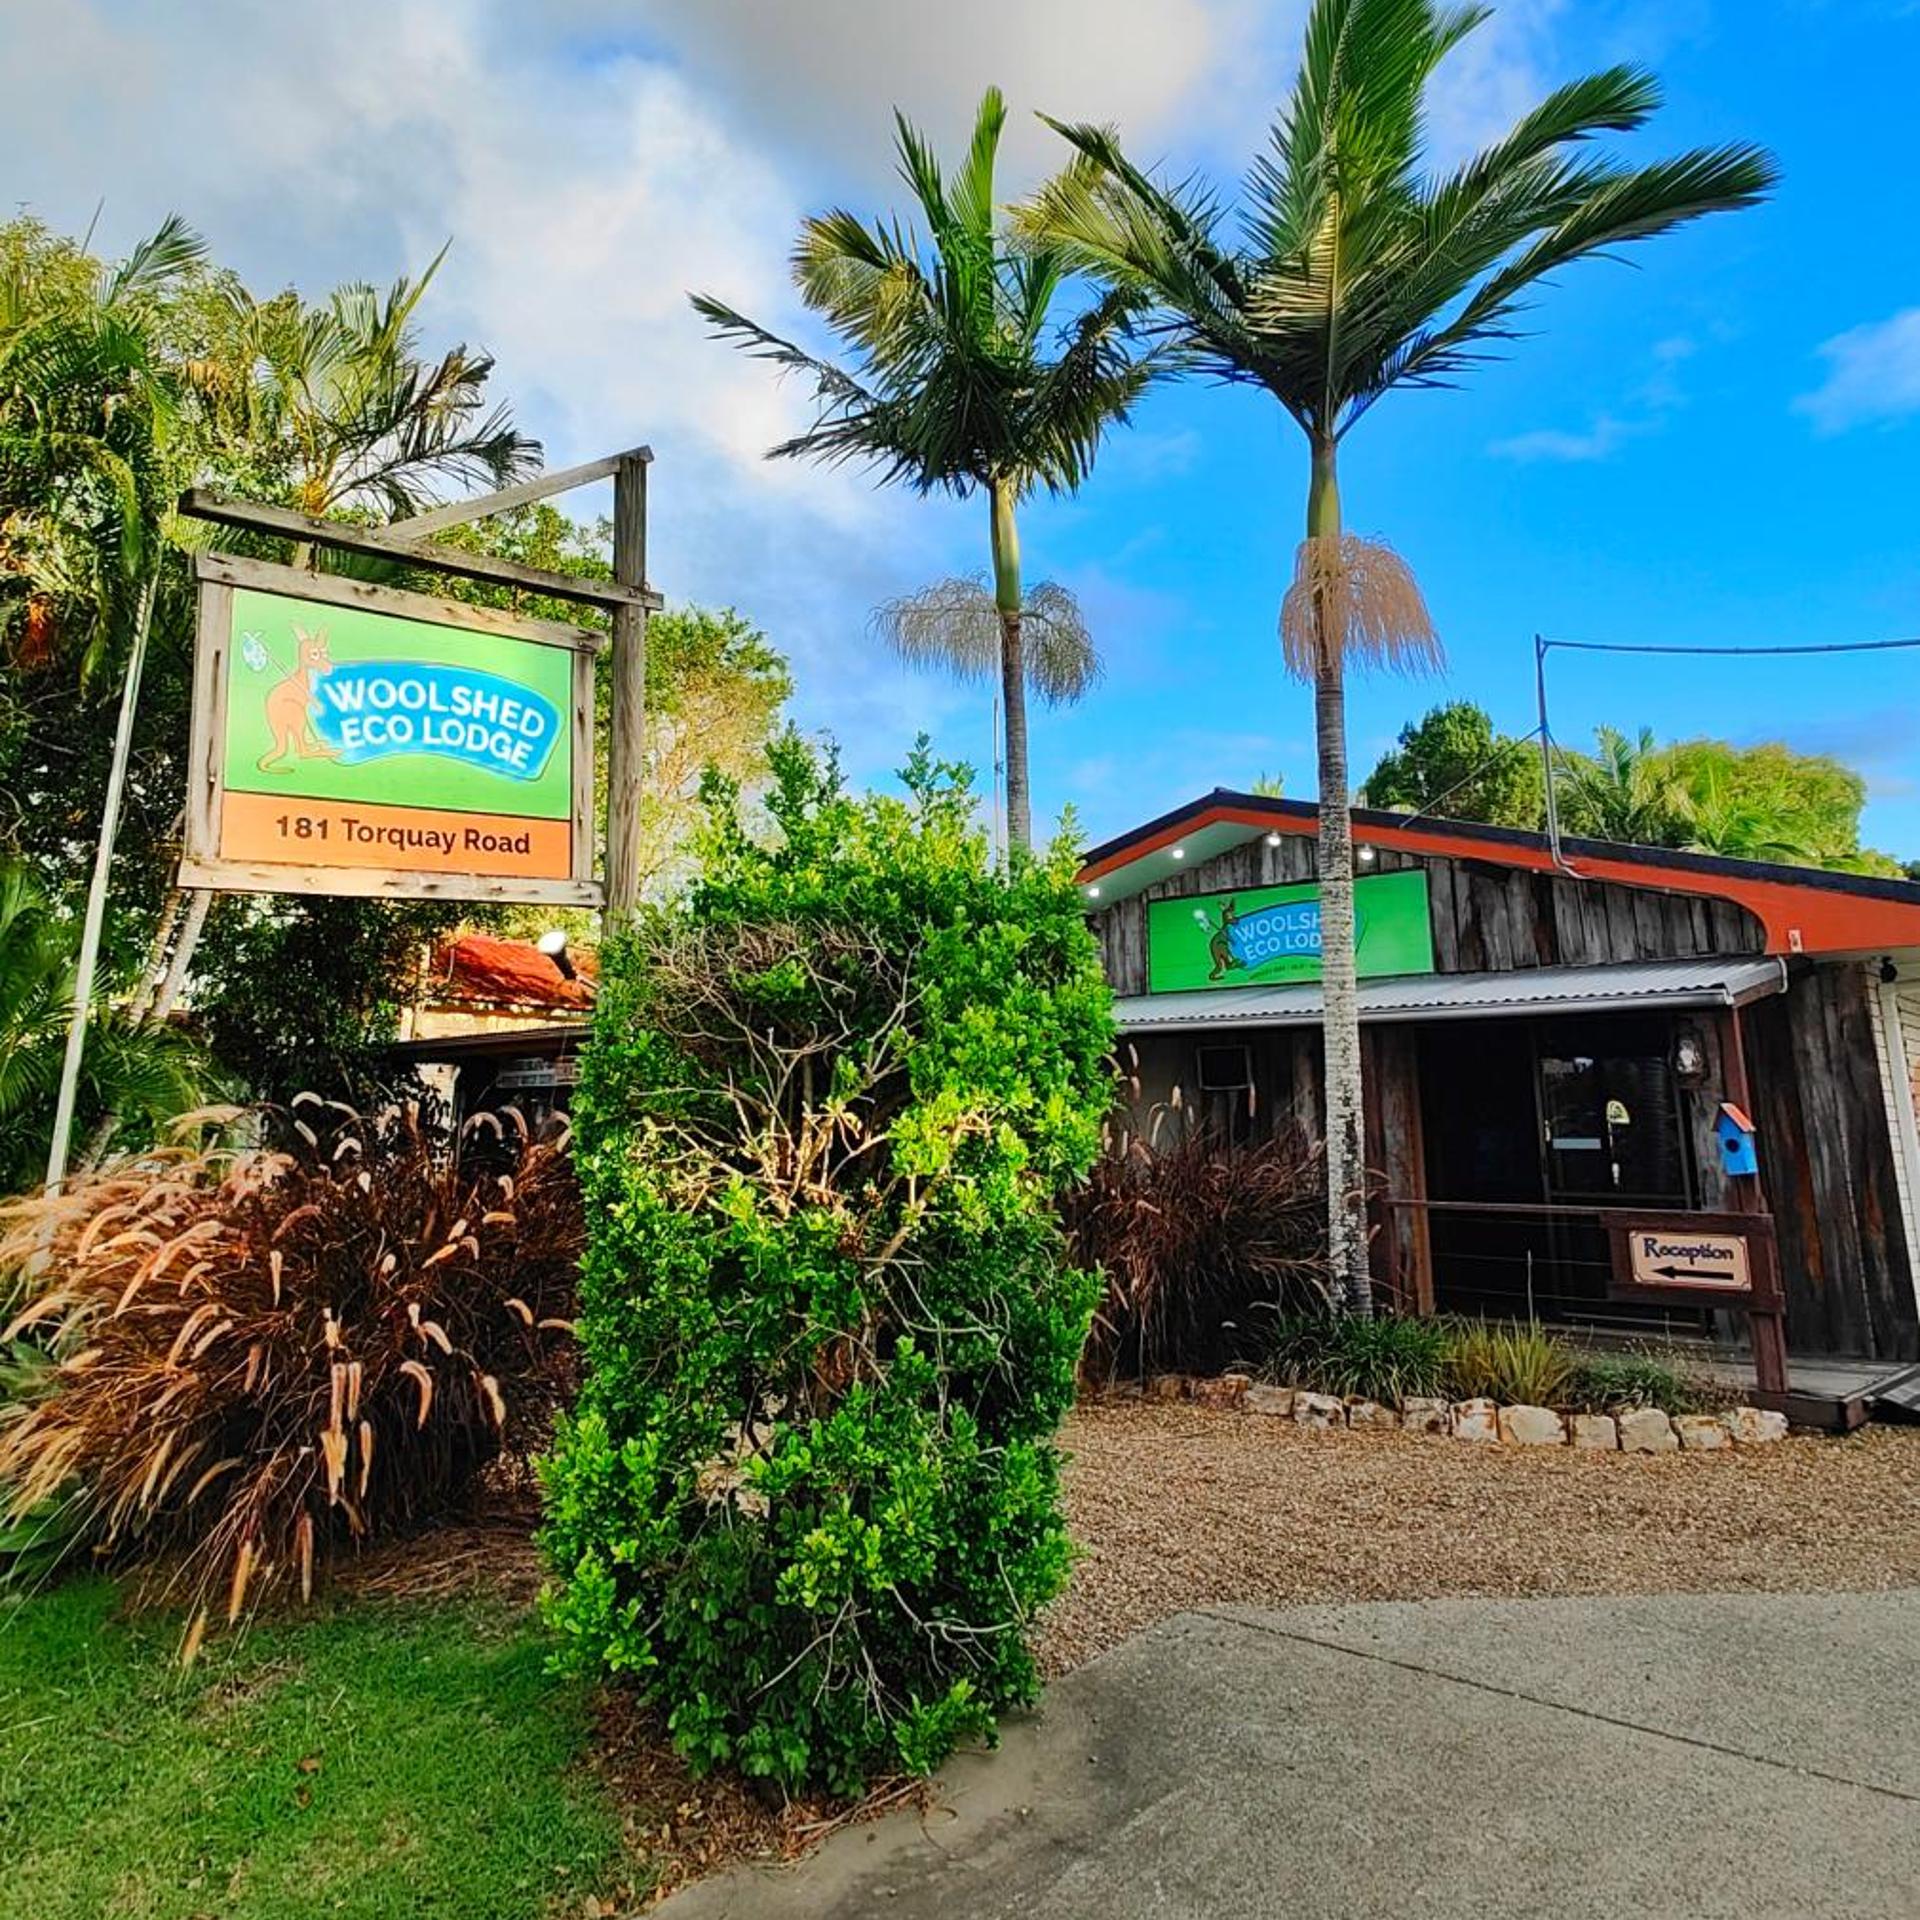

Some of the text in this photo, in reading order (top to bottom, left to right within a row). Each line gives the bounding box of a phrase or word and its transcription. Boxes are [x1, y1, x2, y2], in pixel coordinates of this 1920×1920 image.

[324, 678, 545, 738] WOOLSHED
[340, 714, 533, 769] ECO LODGE
[276, 815, 531, 855] 181 Torquay Road
[1235, 911, 1322, 943] WOOLSH
[1244, 932, 1322, 961] ECO LOD
[1643, 1237, 1734, 1265] Reception
